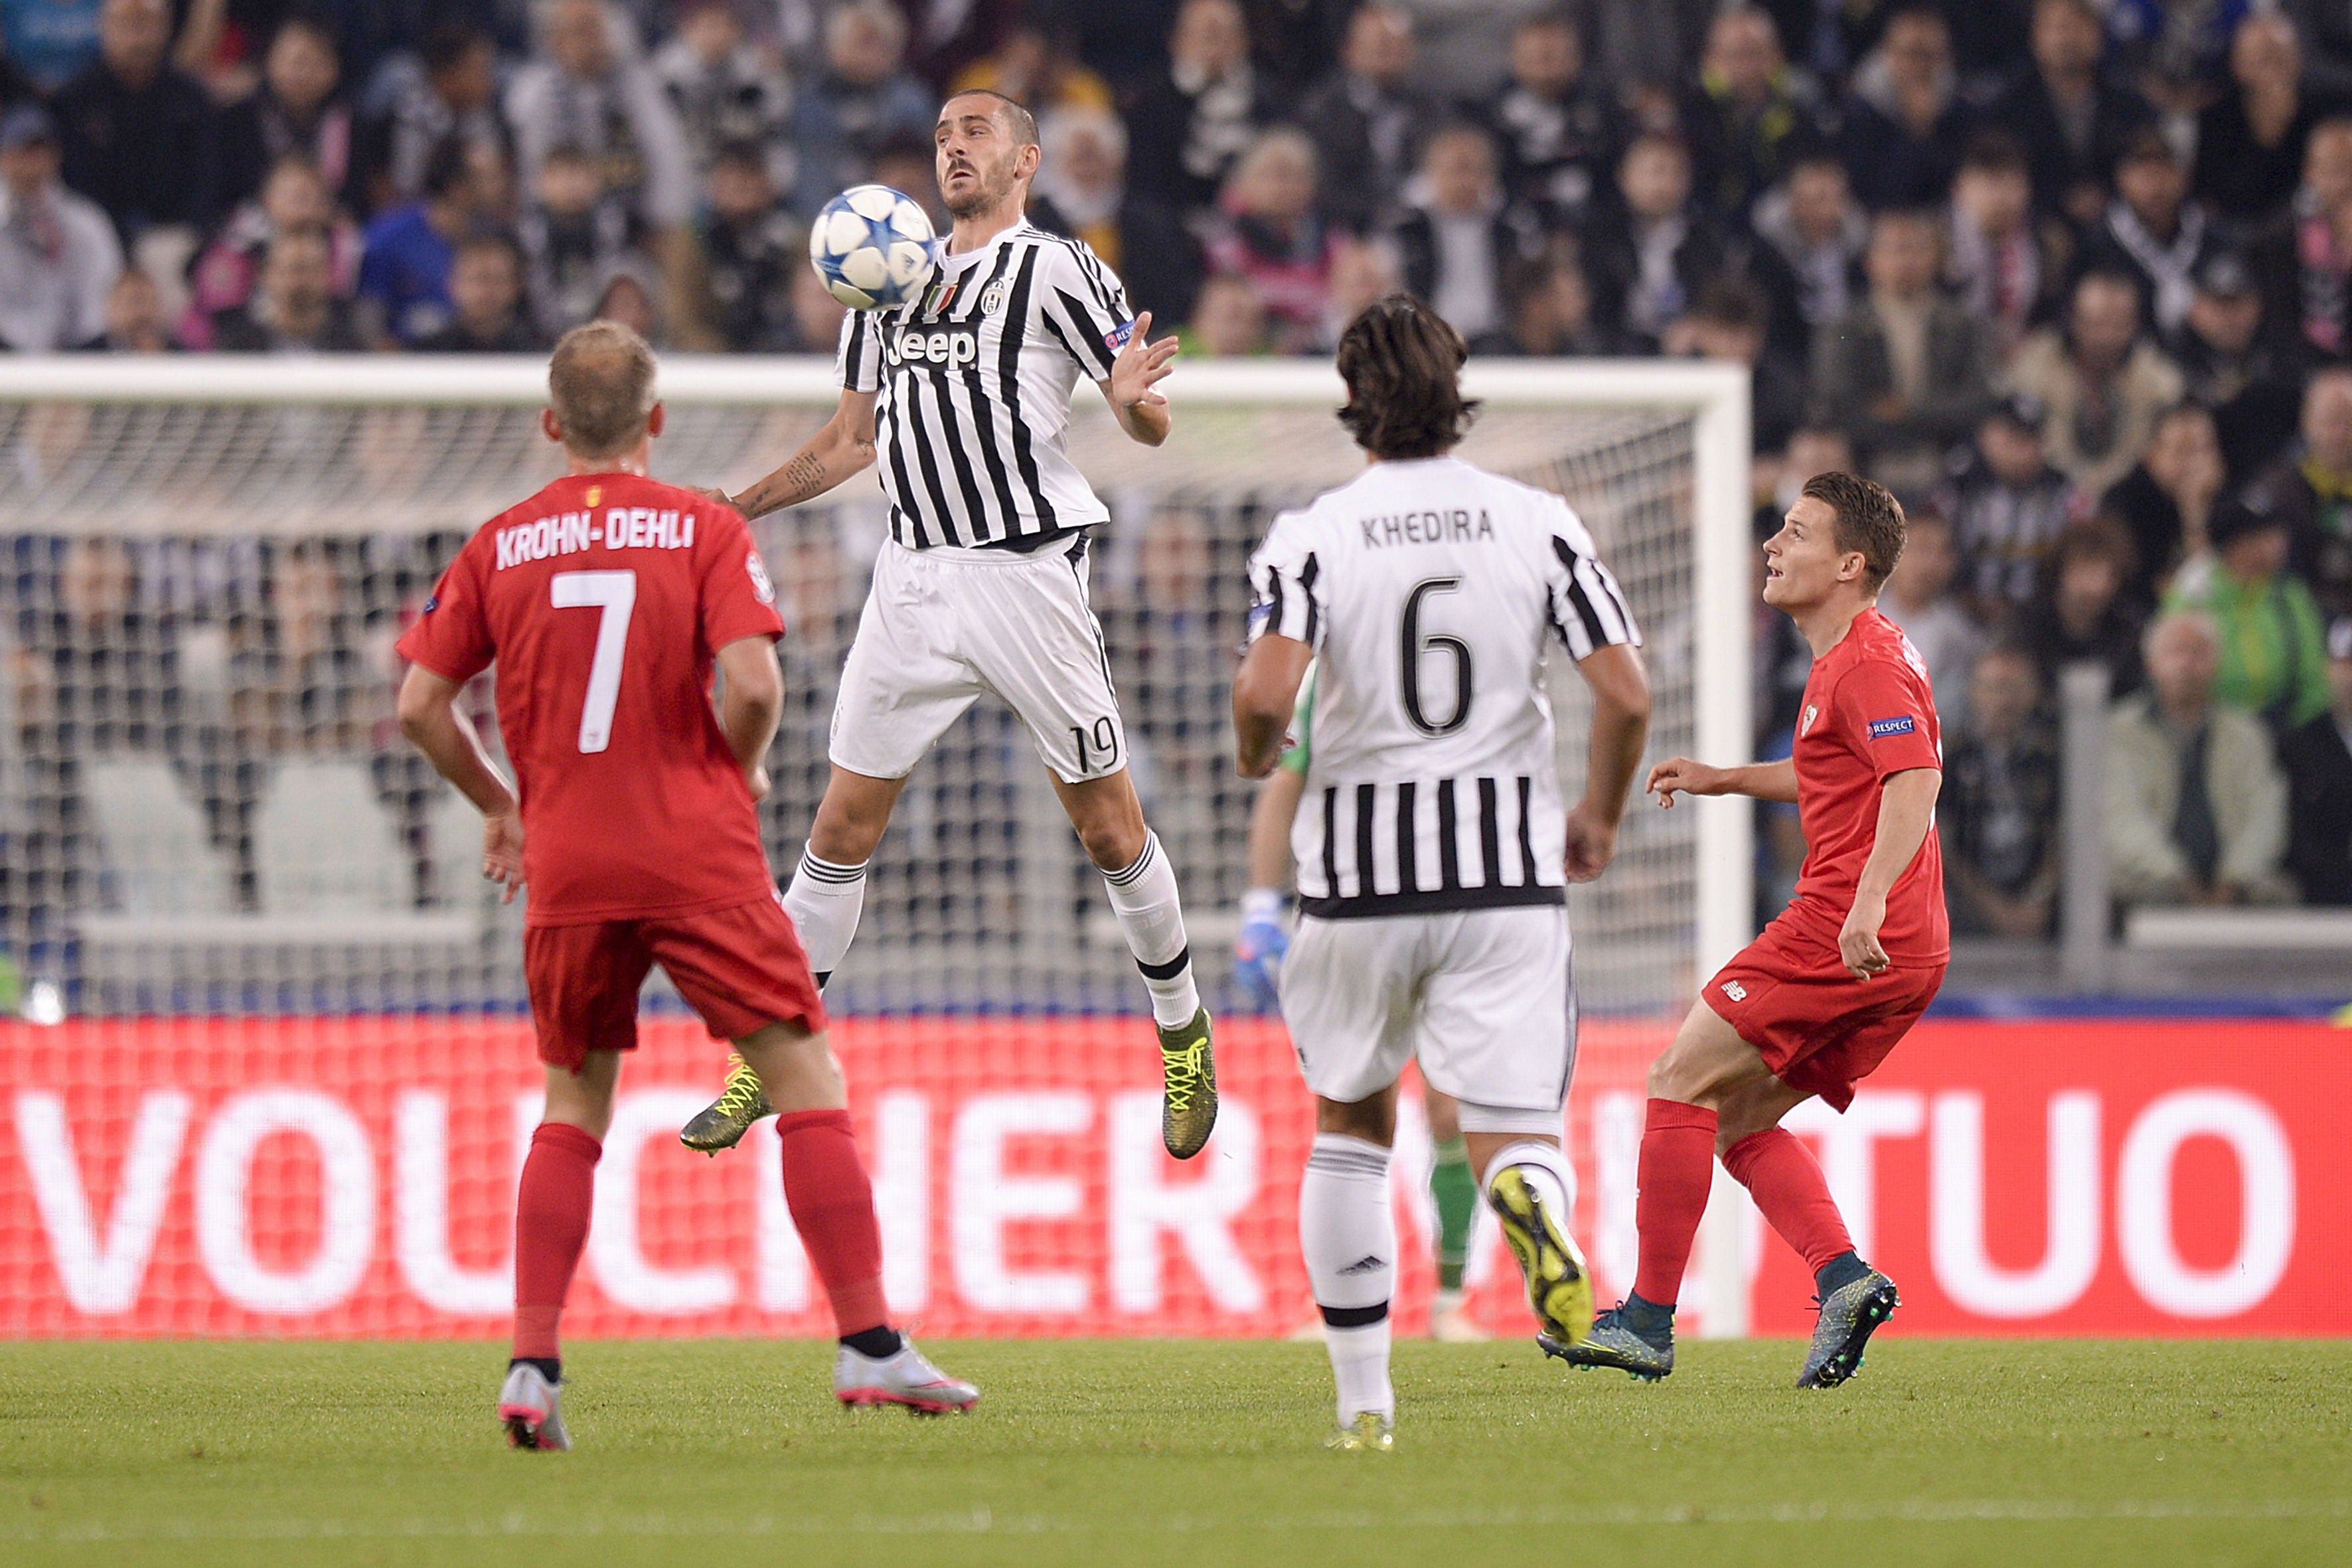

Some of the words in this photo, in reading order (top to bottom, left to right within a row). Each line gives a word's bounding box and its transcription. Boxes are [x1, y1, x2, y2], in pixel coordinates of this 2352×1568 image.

[888, 333, 977, 370] Jeep
[496, 508, 695, 571] KROHN-DEHLI
[1362, 508, 1494, 550] KHEDIRA
[550, 569, 637, 753] 7
[1397, 576, 1474, 740] 6
[1069, 716, 1118, 774] 19
[1873, 719, 1913, 734] RESPECT
[13, 1087, 1263, 1314] VOUCHER
